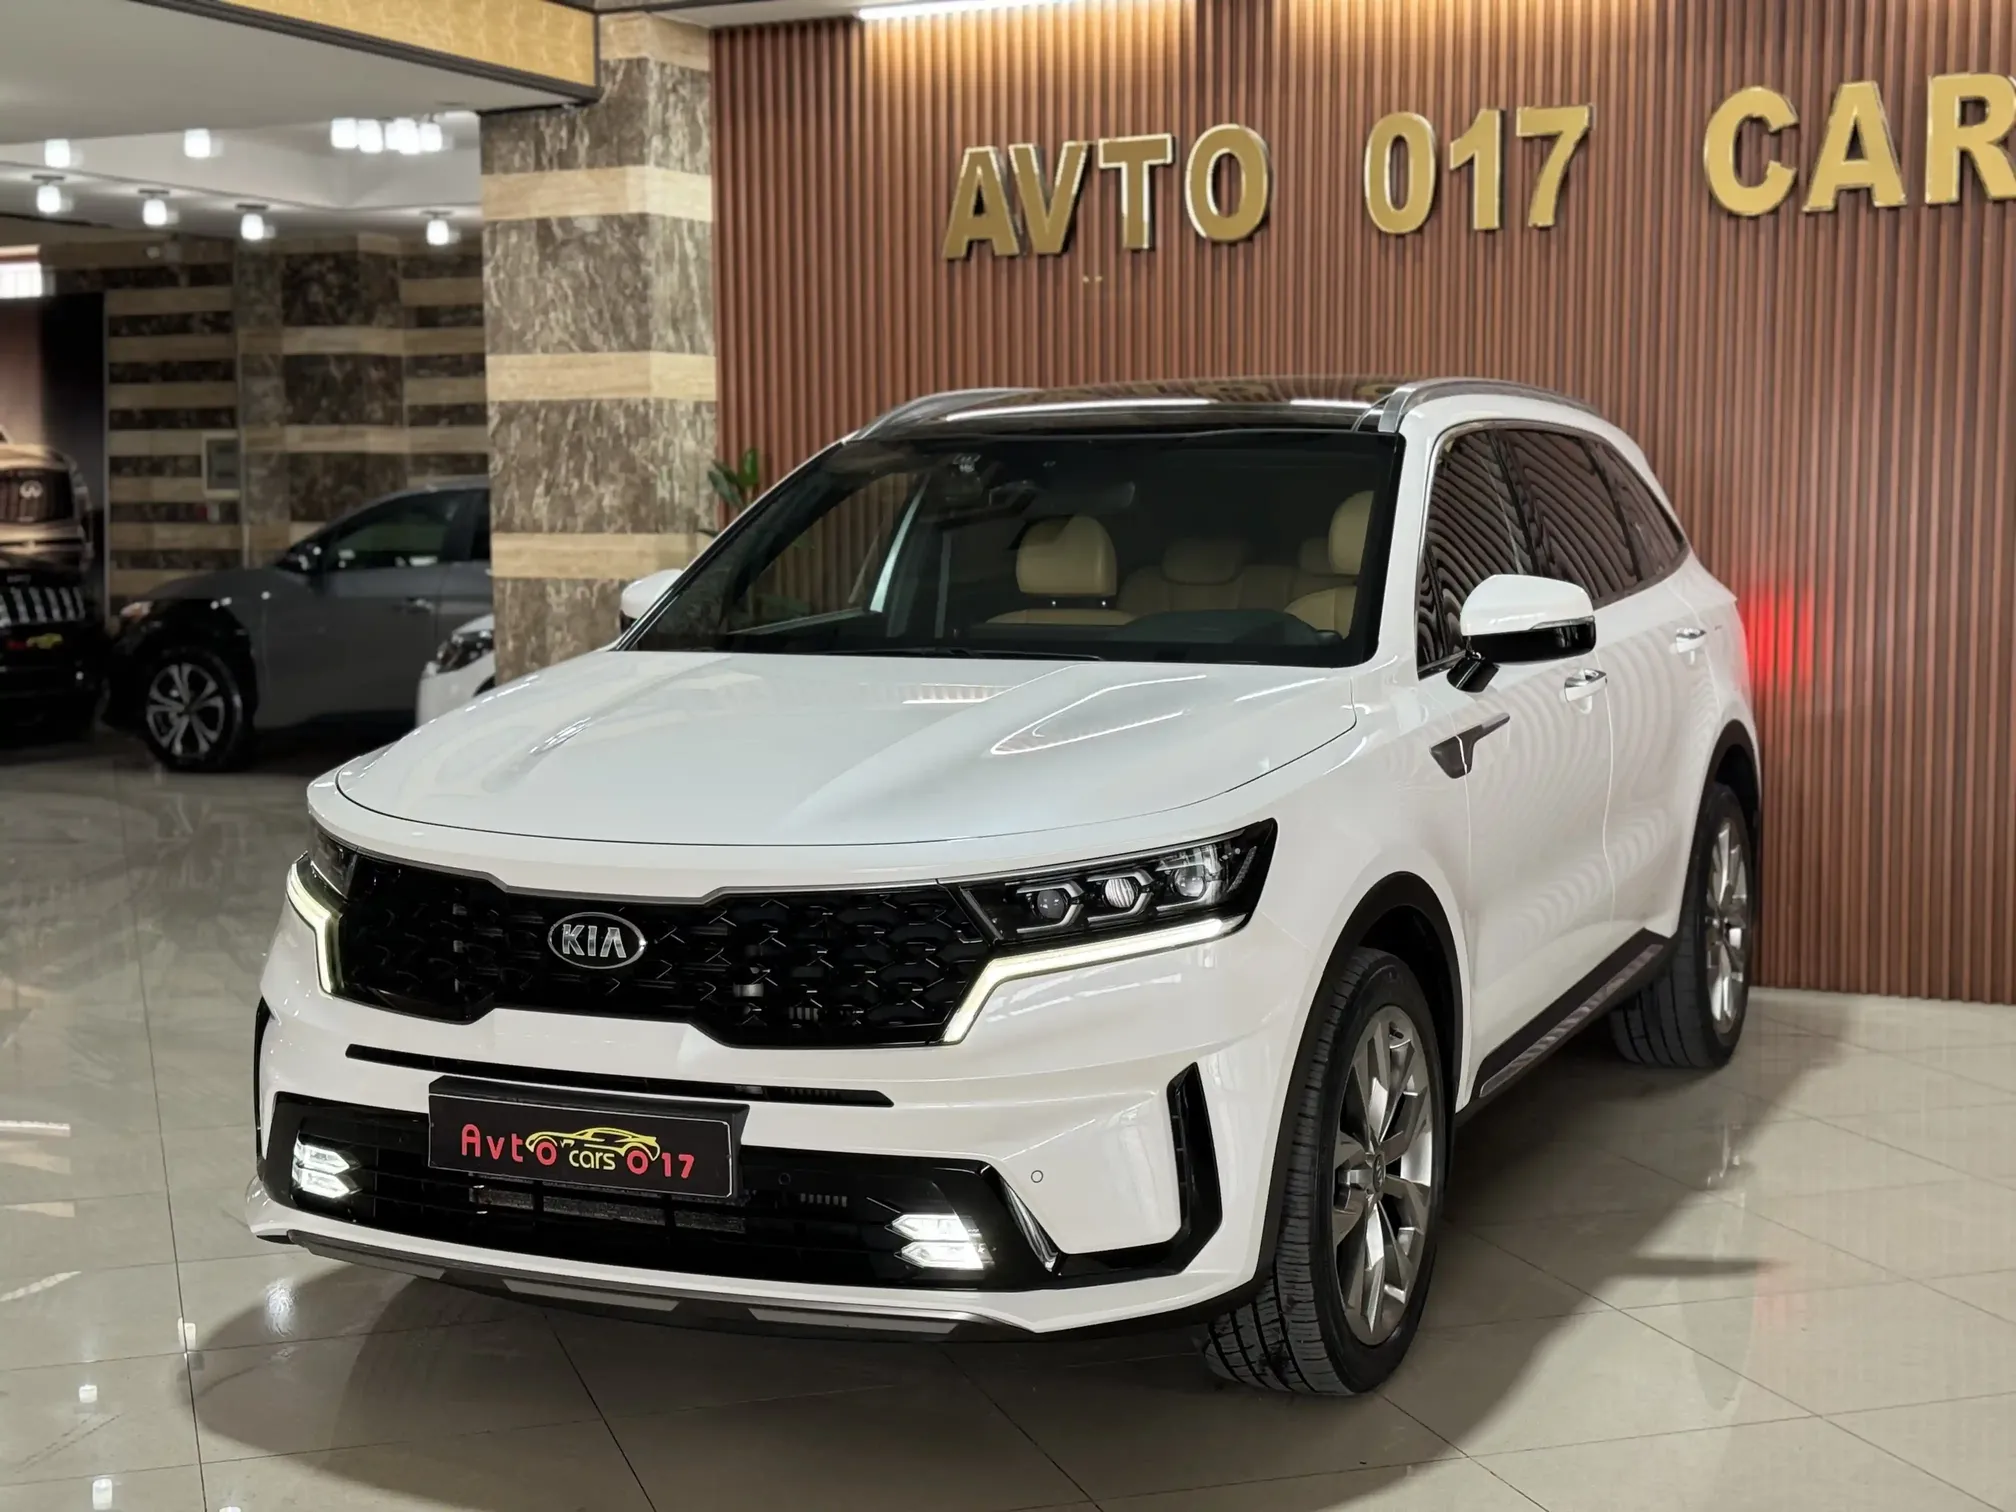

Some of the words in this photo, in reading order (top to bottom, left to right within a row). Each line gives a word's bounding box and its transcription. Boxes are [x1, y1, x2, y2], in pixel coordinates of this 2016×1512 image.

[942, 123, 1269, 258] AVTO
[1364, 103, 1591, 235] 017
[562, 923, 627, 958] KIA
[568, 1149, 617, 1171] cars
